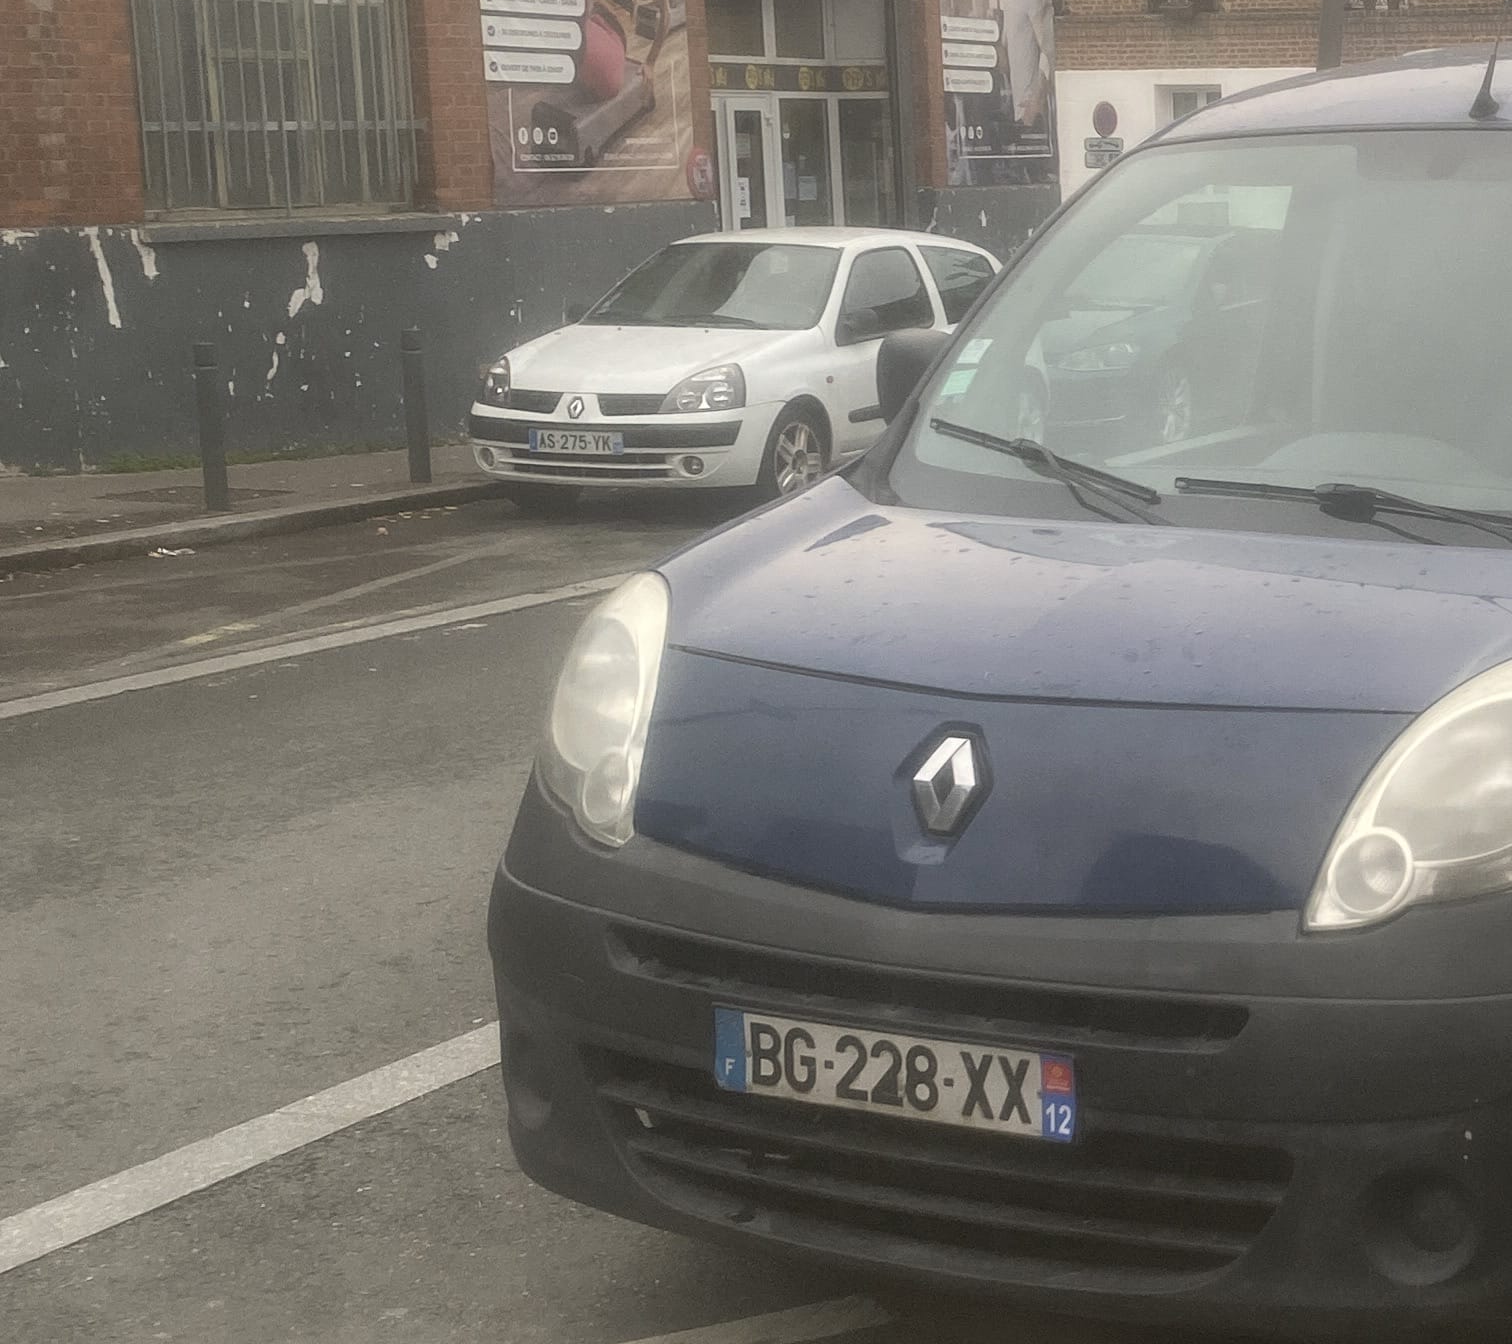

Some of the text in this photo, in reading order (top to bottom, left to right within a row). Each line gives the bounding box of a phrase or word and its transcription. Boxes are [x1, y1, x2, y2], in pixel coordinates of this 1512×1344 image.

[539, 432, 612, 452] AS-275-YK
[725, 1057, 736, 1076] F
[749, 1021, 1031, 1125] BG-228-XX
[1045, 1103, 1072, 1135] 12
